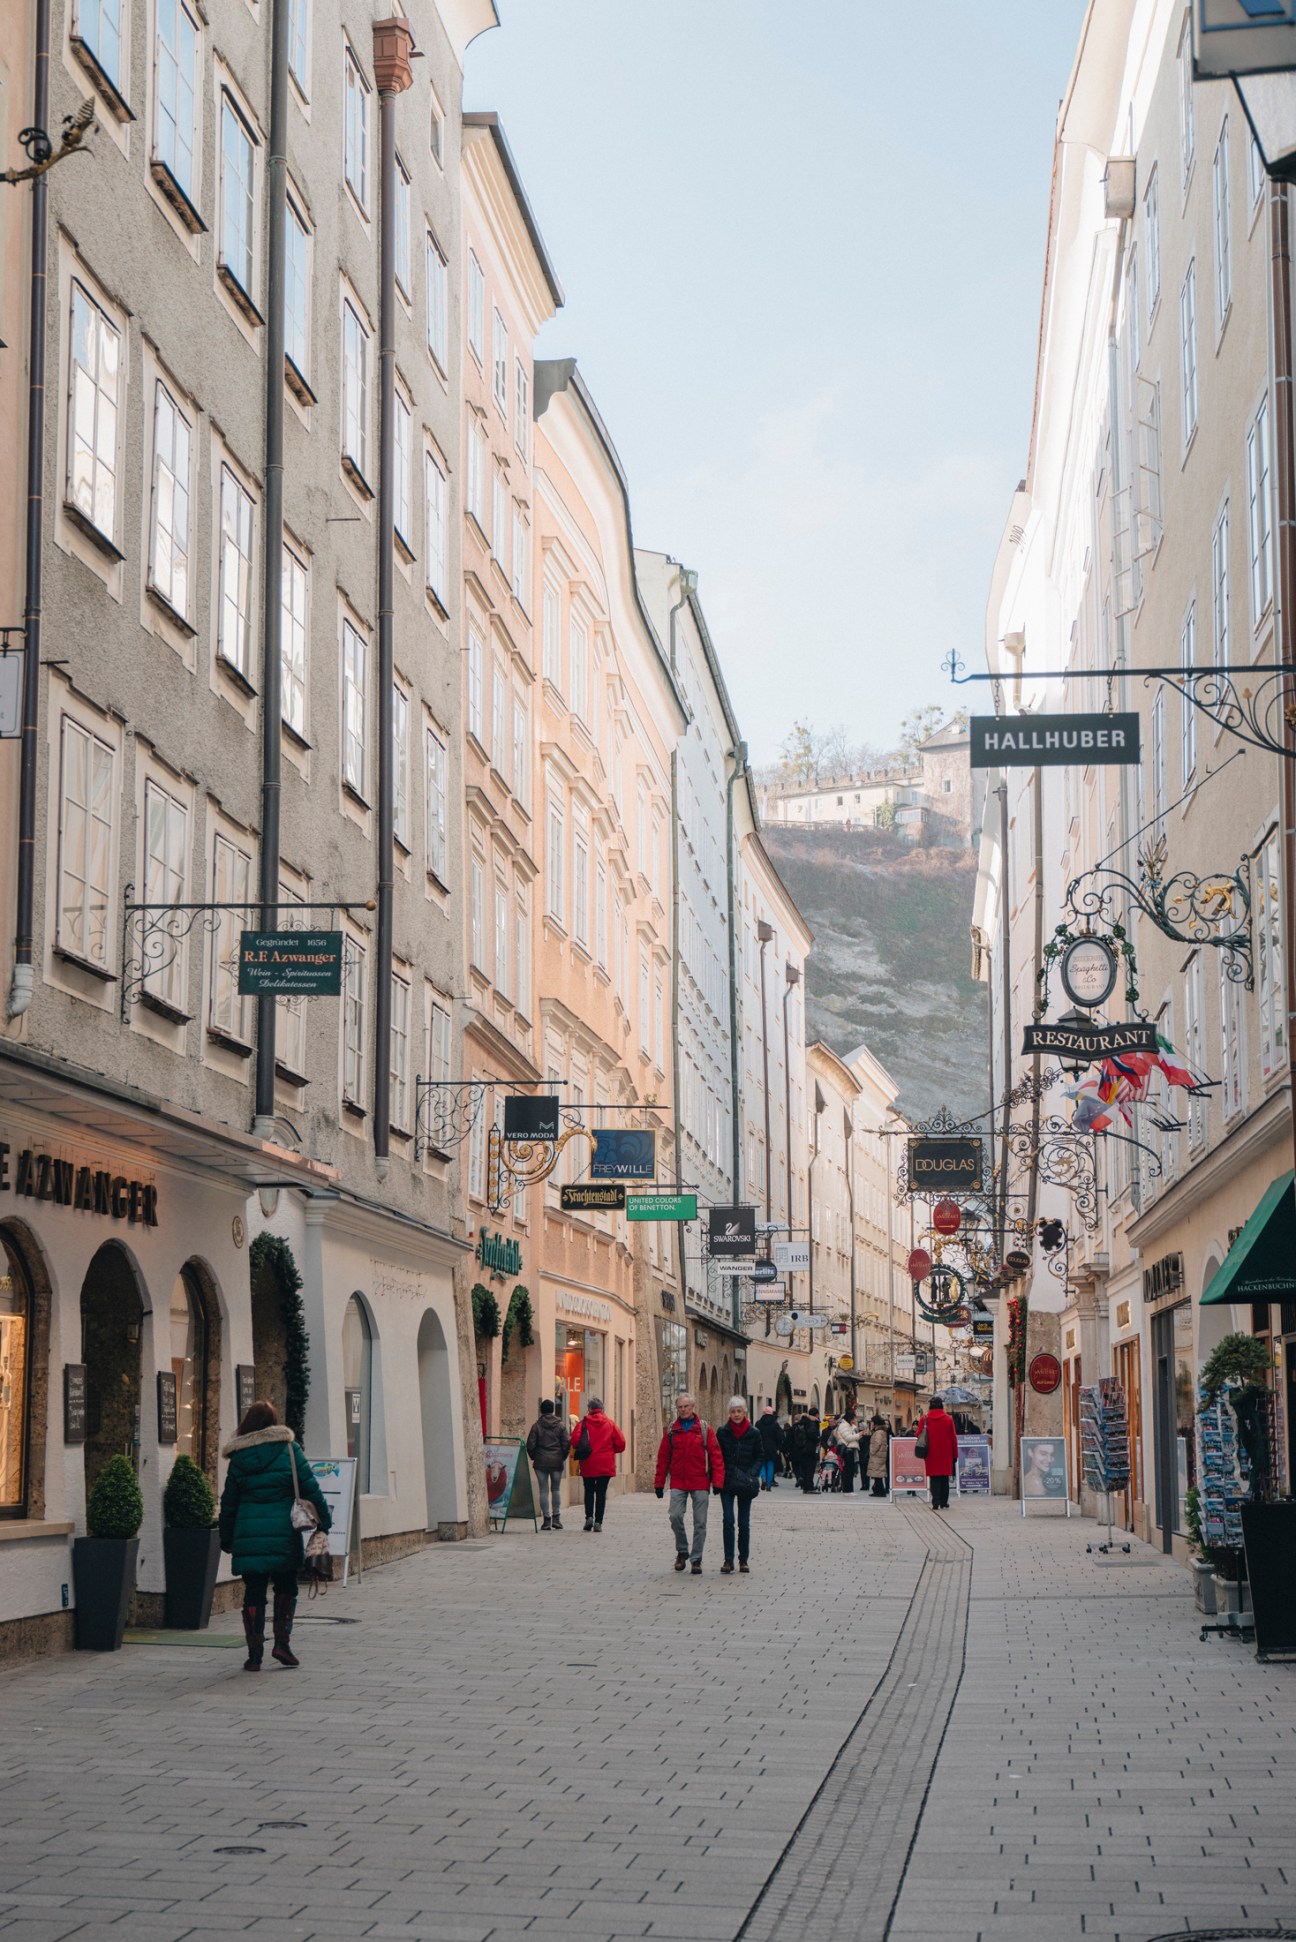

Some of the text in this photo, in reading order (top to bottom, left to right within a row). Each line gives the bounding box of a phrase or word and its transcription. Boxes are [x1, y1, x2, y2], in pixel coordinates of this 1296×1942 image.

[984, 730, 1126, 750] HALLHUBER
[256, 938, 299, 947] Gegründet
[271, 950, 336, 965] Azwanger
[247, 967, 272, 977] Wein
[282, 967, 331, 978] Spirituosen
[1070, 963, 1108, 975] Spaghetti
[258, 979, 317, 988] Delikatessen
[1032, 1030, 1150, 1051] RESTAURANT
[593, 1164, 653, 1174] FREYWILLE
[915, 1158, 975, 1172] DOUGLAS
[15, 1149, 159, 1227] AZWANGER
[713, 1234, 752, 1243] SWAROVSKI
[1008, 1255, 1029, 1265] DOUGLAS
[755, 1267, 775, 1275] erlitz
[1237, 1283, 1296, 1291] HACKENBUCHN
[559, 1376, 581, 1393] ALE
